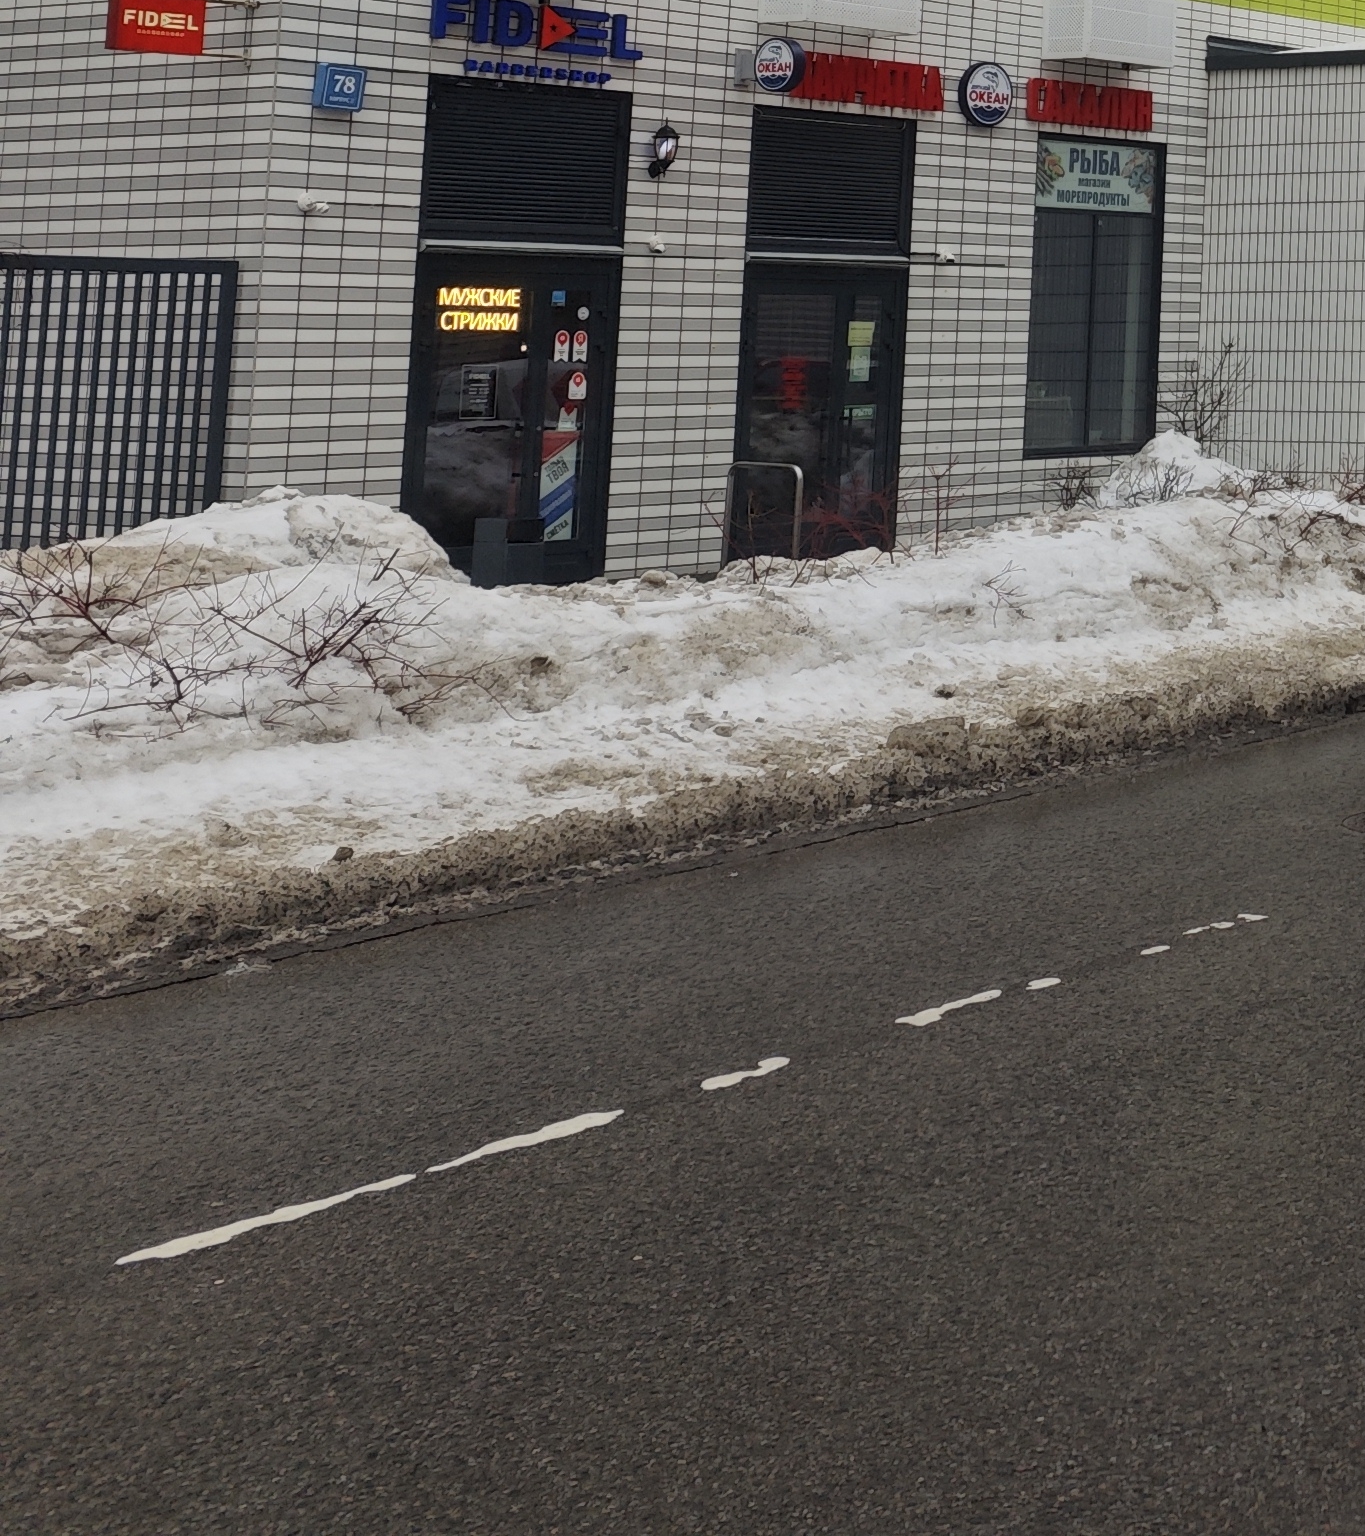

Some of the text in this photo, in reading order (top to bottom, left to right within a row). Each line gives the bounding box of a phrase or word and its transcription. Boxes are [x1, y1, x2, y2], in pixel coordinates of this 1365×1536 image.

[123, 9, 199, 31] FIDEL
[757, 62, 792, 73] ОКЕАН
[334, 75, 356, 94] 78
[969, 90, 1010, 106] ОКЕАН
[1026, 78, 1153, 132] САХАЛИН
[1069, 148, 1121, 176] РЫБА
[439, 287, 521, 308] МУЖСКИЕ
[440, 311, 519, 331] СТРИЖКИ
